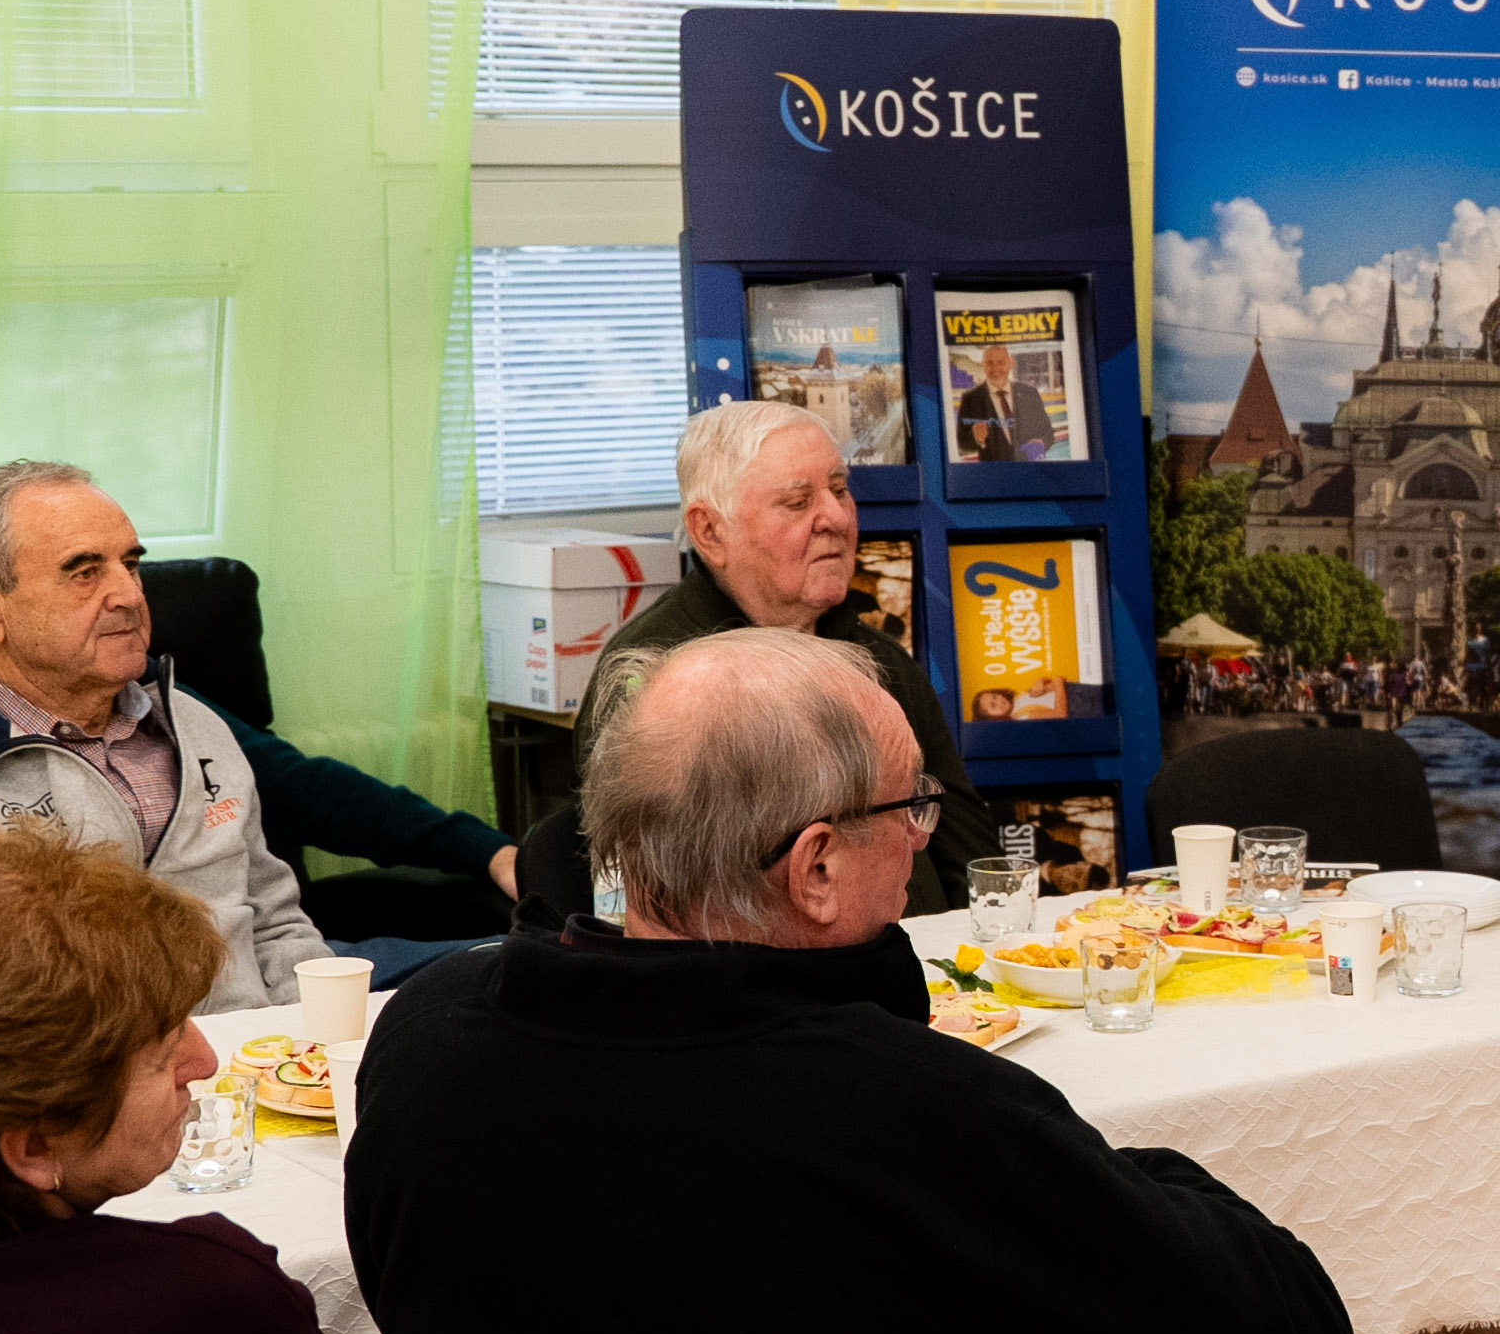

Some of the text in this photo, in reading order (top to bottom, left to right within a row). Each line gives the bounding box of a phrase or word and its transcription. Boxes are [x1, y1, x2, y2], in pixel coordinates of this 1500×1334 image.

[1263, 72, 1328, 85] kosice.sk
[1365, 74, 1411, 88] Košice
[1426, 76, 1468, 88] Mesto
[840, 77, 1041, 139] KOŠICE
[944, 310, 1060, 335] VÝSLEDKY
[773, 326, 879, 344] V SKRATKE
[528, 642, 547, 658] Copy
[564, 699, 578, 709] A4
[1, 797, 57, 819] GRND
[203, 811, 238, 829] CLUB
